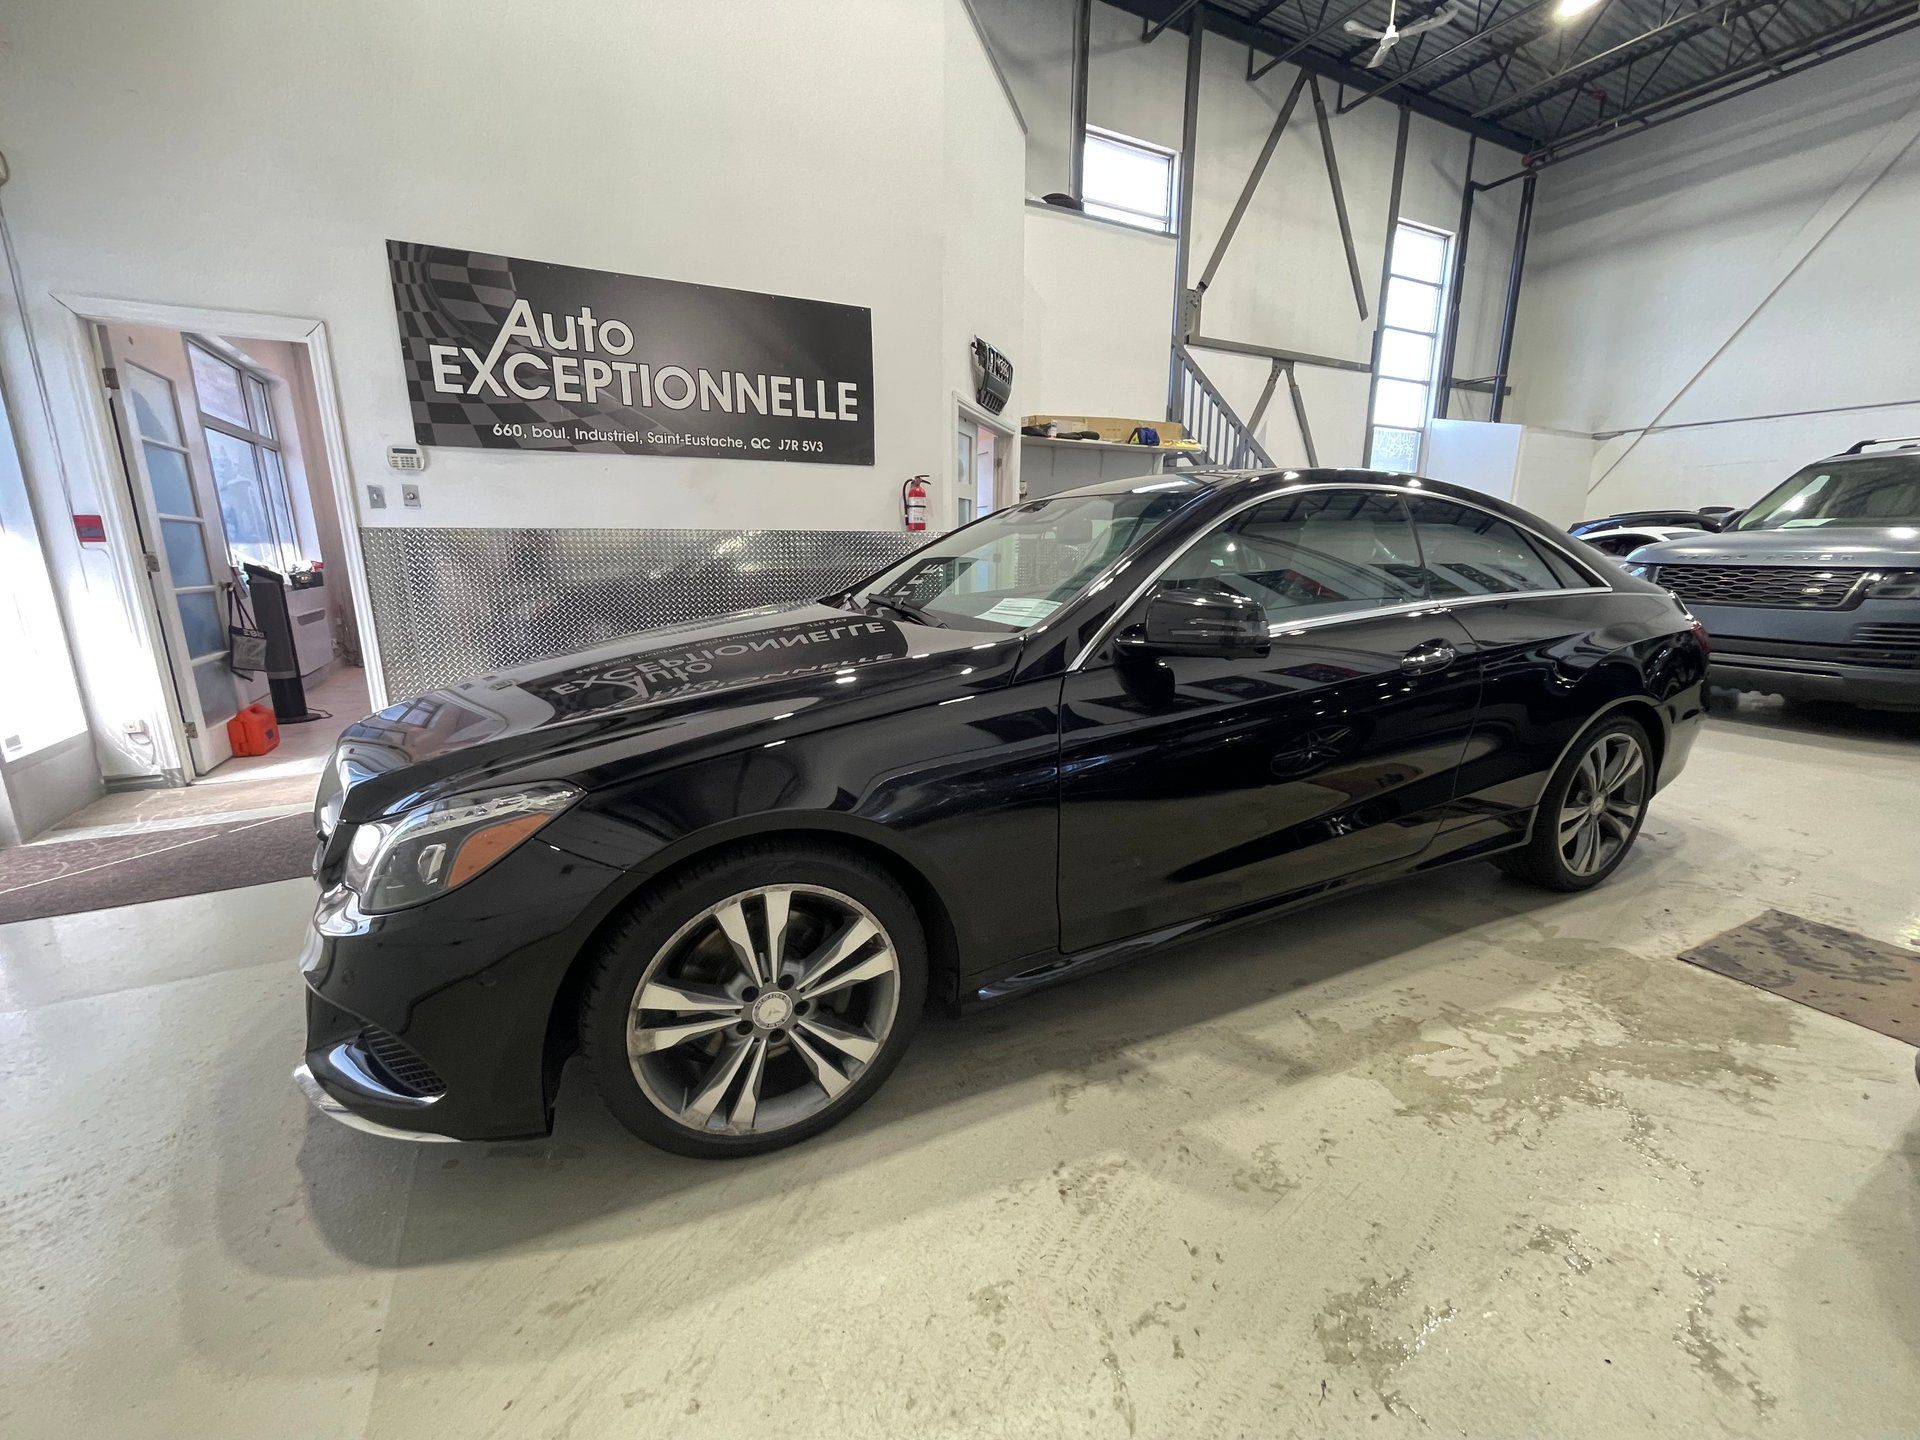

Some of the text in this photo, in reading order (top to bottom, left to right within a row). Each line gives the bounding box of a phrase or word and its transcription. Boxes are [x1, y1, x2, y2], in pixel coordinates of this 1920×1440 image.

[498, 298, 635, 357] Auto
[428, 343, 859, 422] EXCEPTIONNELLE
[492, 423, 824, 453] 660, boul. Industriel, Saint-Eustache, QC J7R 5V3
